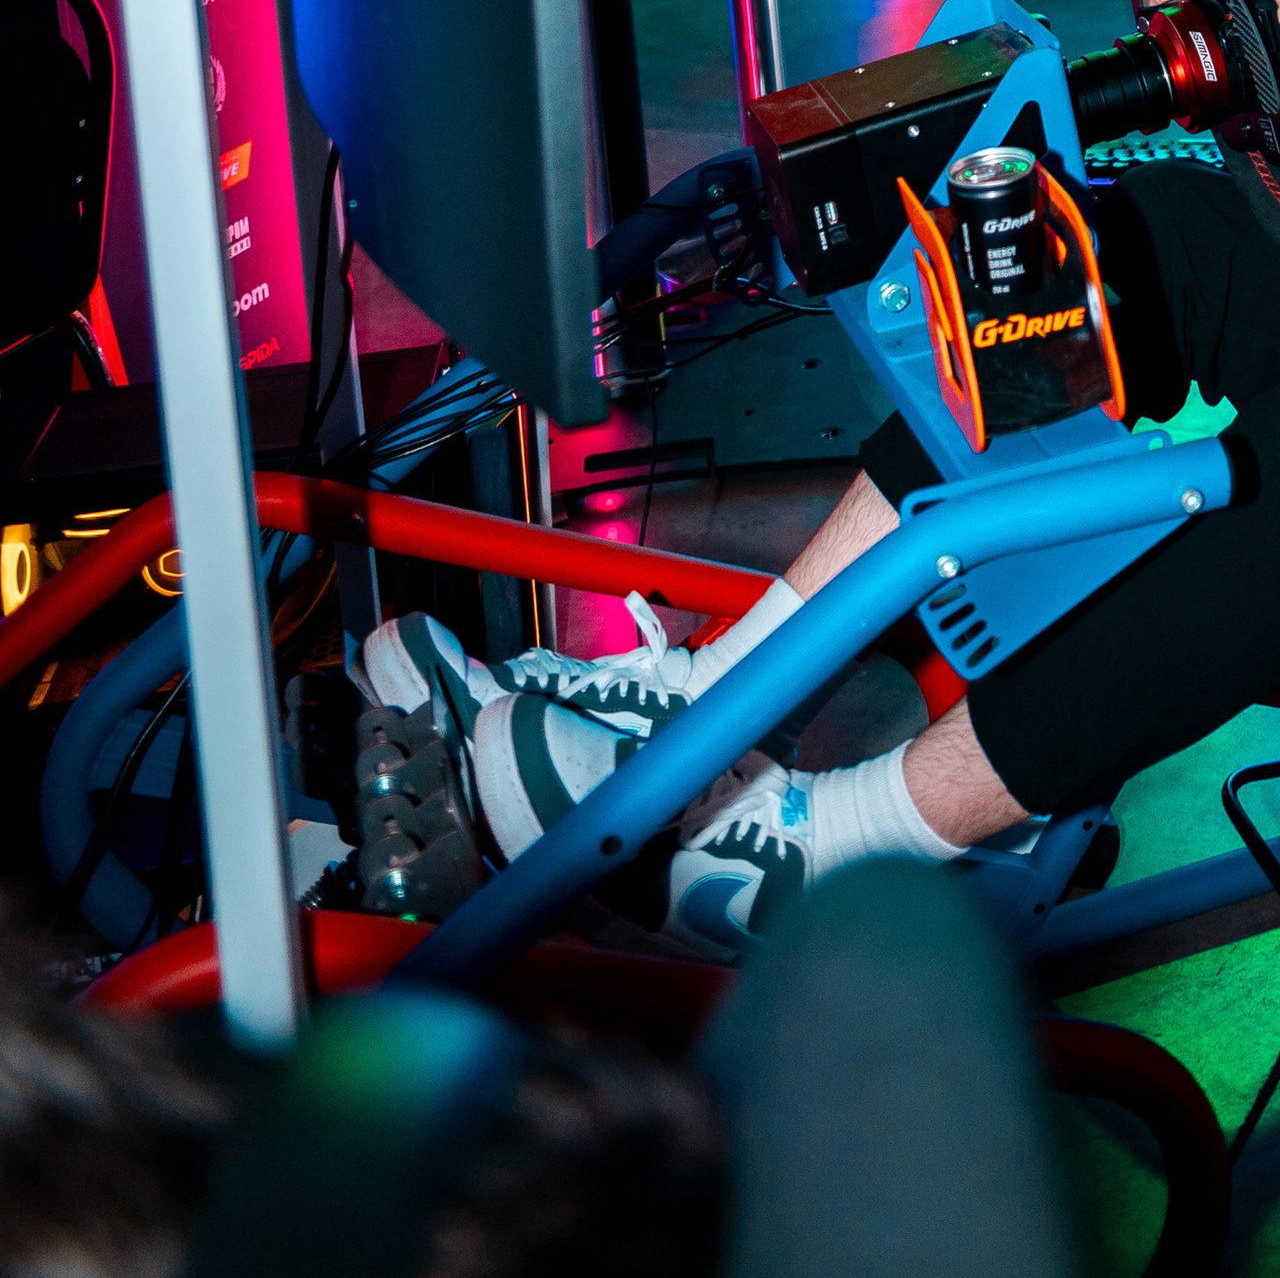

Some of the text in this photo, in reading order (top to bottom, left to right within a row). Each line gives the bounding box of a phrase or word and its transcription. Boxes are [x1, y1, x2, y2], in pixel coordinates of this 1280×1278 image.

[983, 209, 1036, 234] G-DRIVE
[987, 245, 1017, 259] ENERGY
[988, 257, 1014, 270] DRINK
[990, 263, 1026, 280] ORIGINAL
[973, 306, 1087, 349] G-DRIVE
